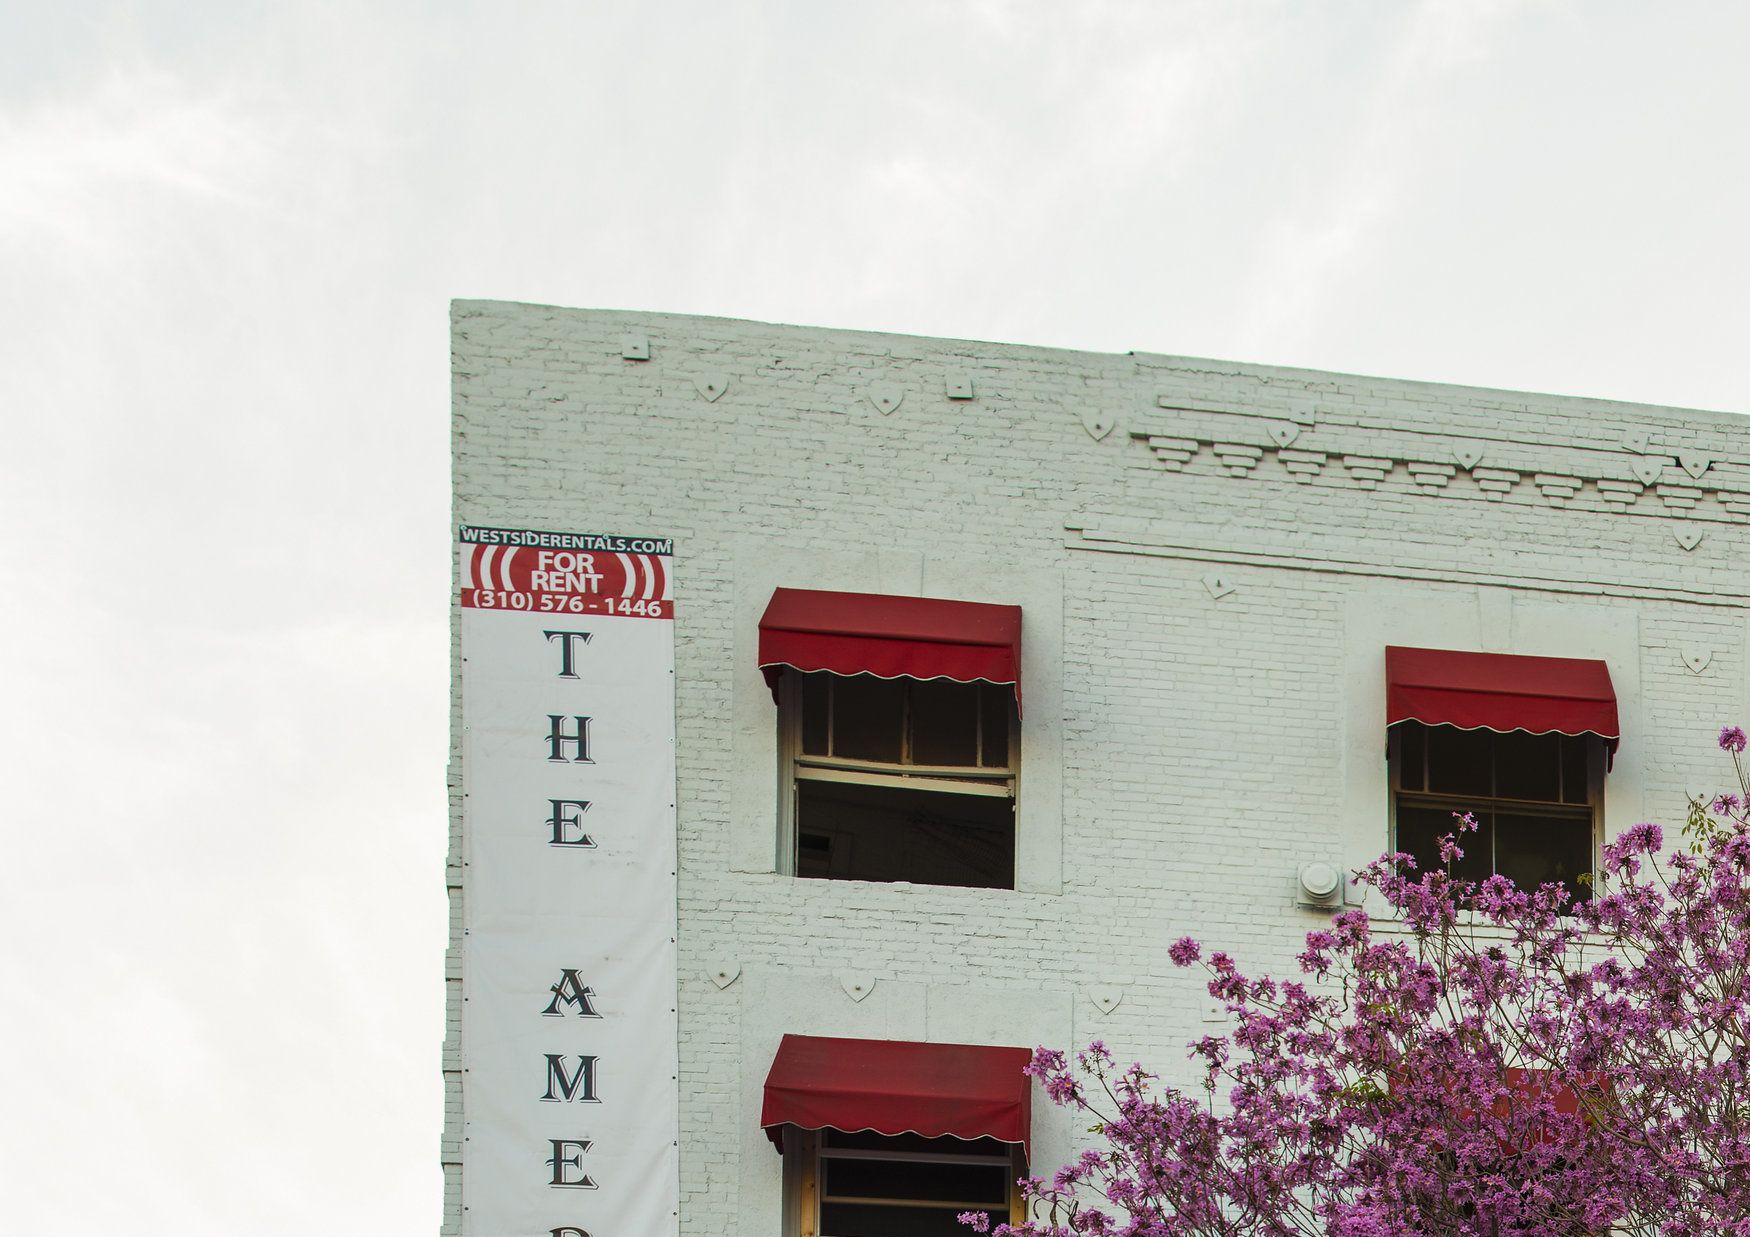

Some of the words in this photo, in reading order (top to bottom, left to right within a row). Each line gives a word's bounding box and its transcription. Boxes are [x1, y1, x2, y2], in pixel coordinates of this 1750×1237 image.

[461, 528, 672, 554] WESTSIDERENTALS.COM
[538, 550, 595, 574] FOR
[531, 570, 604, 594] RENT
[473, 589, 533, 611] (310)
[540, 595, 584, 613] 576
[604, 597, 662, 617] 1446
[542, 629, 599, 849] THE
